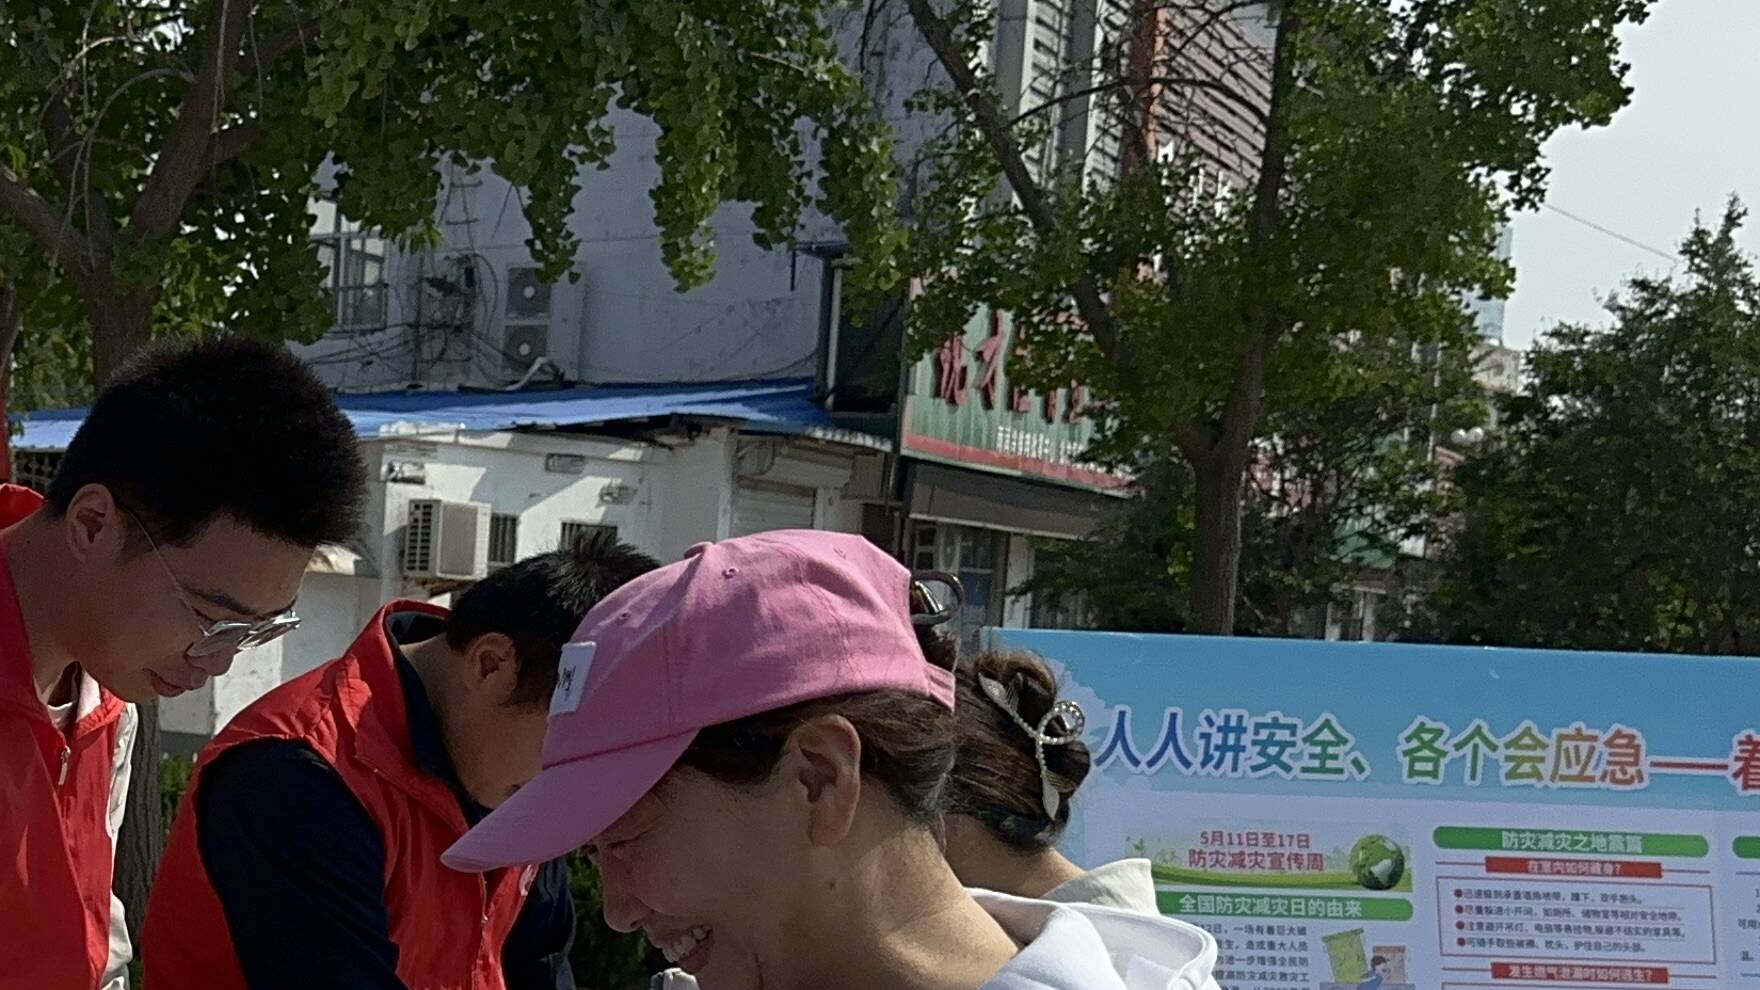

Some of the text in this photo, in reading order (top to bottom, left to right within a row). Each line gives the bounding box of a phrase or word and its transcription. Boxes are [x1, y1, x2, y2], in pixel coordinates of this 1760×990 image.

[1199, 829, 1311, 850] 5月11日至17日
[1501, 830, 1643, 855] 防灾减灾之地震篇
[1187, 848, 1326, 872] 防灾减灾宣传周
[1178, 893, 1363, 919] 全国防灾减灾日的由来
